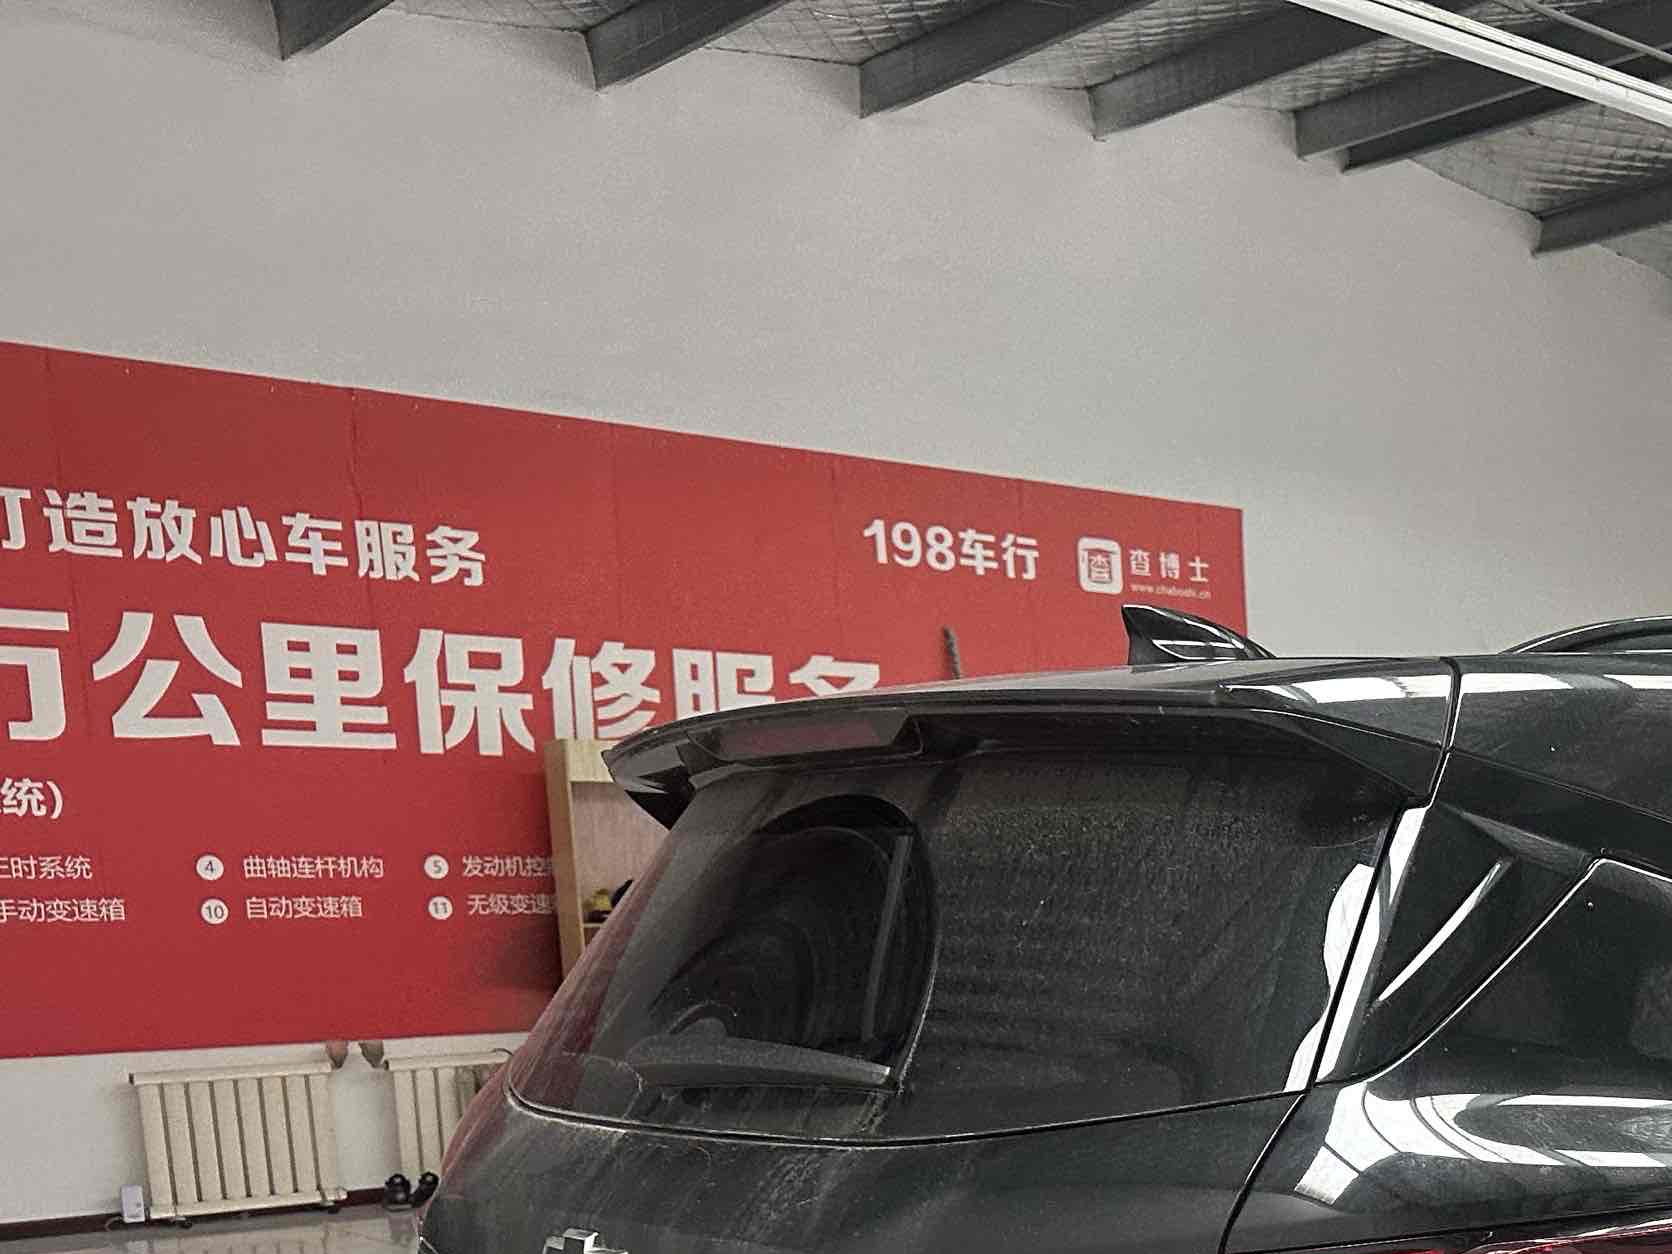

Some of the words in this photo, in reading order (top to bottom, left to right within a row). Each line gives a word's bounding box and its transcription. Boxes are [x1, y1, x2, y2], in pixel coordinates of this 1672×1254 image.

[863, 518, 1039, 580] 198车行
[1130, 549, 1209, 582] 查博士
[0, 778, 63, 819] 统)
[243, 855, 384, 879] 曲轴连杆机构
[462, 855, 556, 877] 发动机控
[205, 904, 224, 919] 10
[246, 895, 363, 920] 自动变速箱
[433, 901, 449, 915] 11
[467, 893, 555, 916] 无级变速
